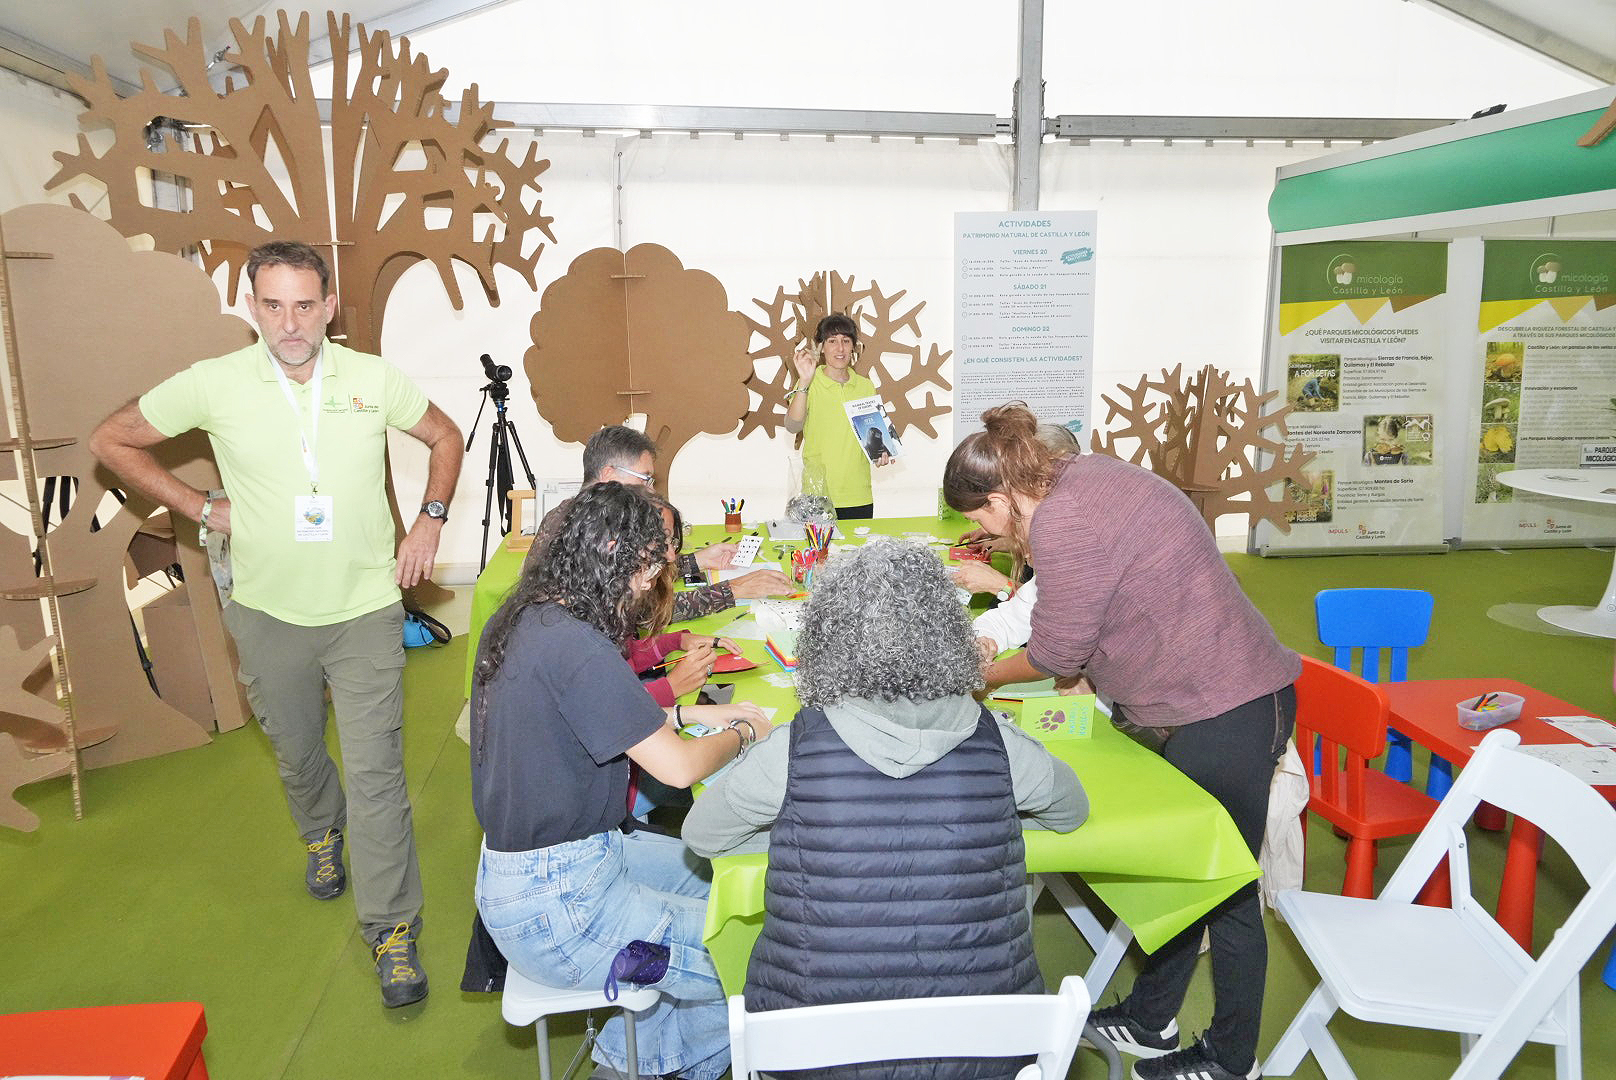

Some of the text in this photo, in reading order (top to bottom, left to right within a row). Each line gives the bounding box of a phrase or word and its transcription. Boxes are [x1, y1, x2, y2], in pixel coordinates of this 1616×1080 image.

[1356, 274, 1403, 285] micología
[1561, 273, 1609, 283] micología
[1332, 286, 1368, 295] Castilla
[1380, 286, 1403, 295] León
[1305, 328, 1322, 337] ¿QUÉ
[1300, 369, 1316, 377] POR
[1316, 368, 1336, 377] SETAS
